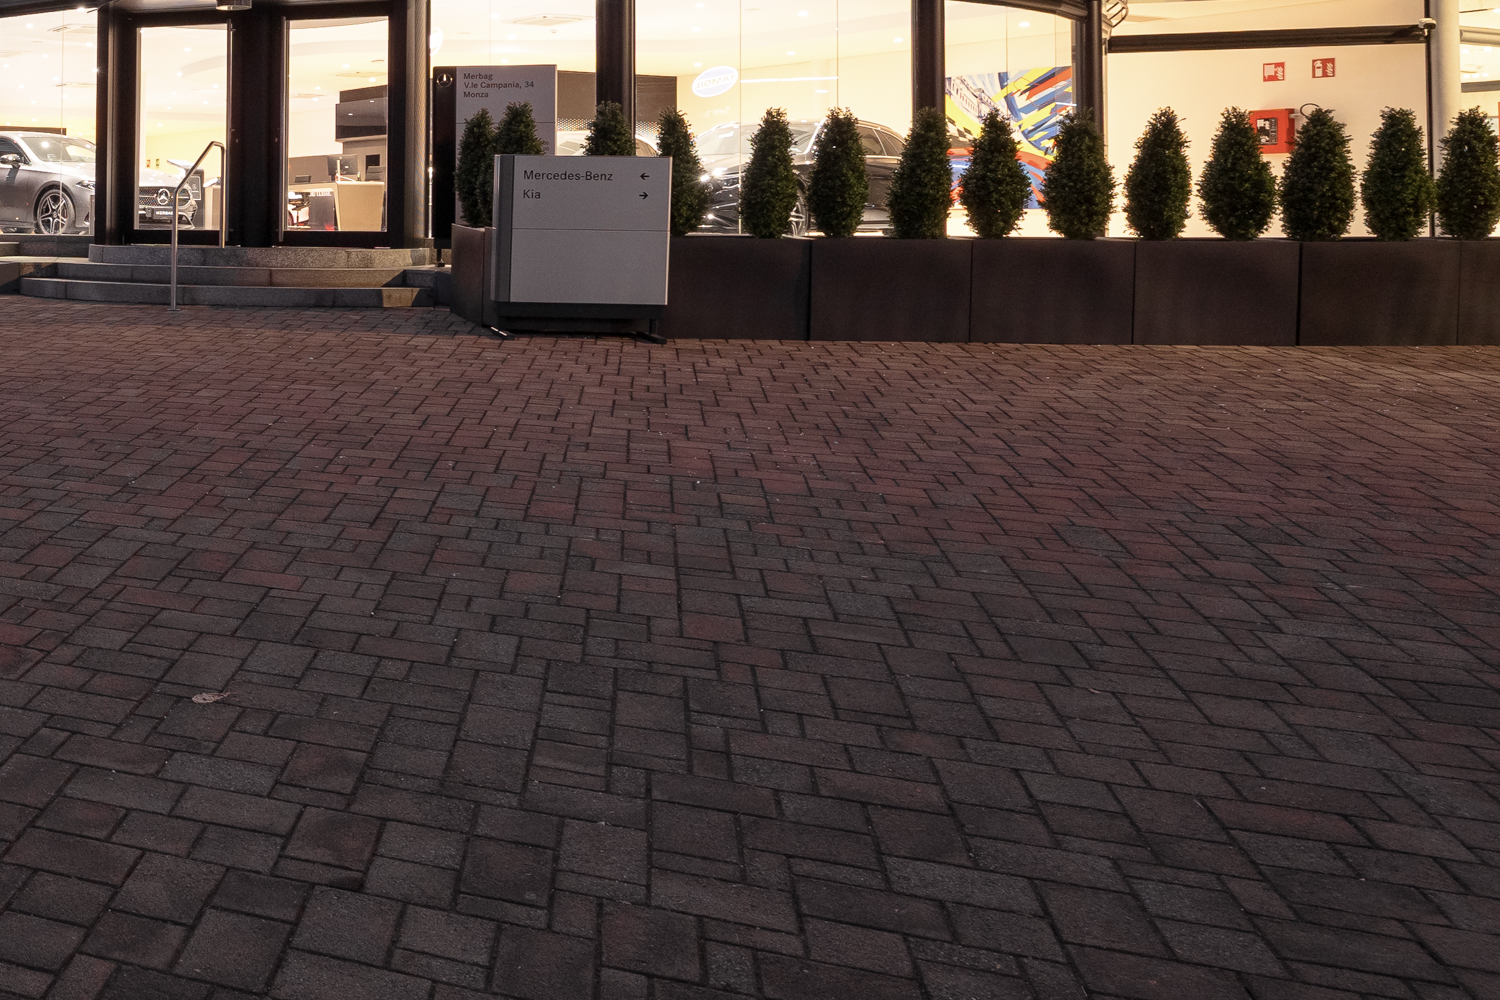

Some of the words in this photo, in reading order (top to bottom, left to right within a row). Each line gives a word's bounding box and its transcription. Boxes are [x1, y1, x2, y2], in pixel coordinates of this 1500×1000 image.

[463, 73, 493, 81] Merbag
[480, 81, 522, 90] Campania,
[523, 169, 614, 181] Mercedes-Benz
[522, 189, 541, 200] Kia
